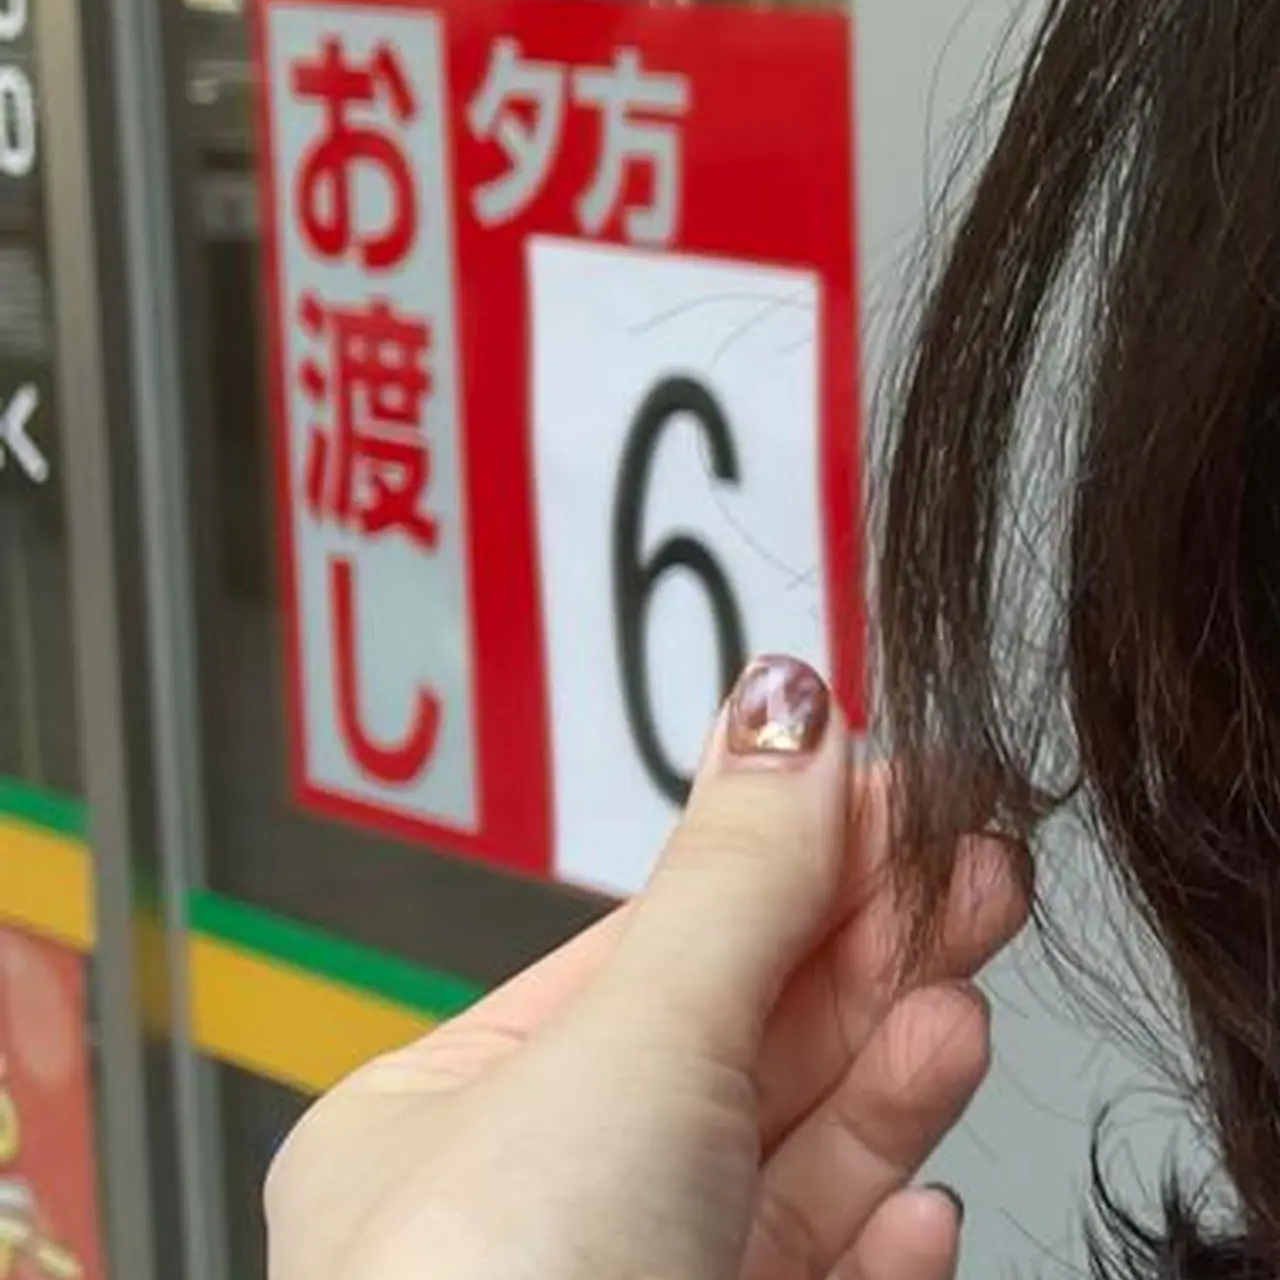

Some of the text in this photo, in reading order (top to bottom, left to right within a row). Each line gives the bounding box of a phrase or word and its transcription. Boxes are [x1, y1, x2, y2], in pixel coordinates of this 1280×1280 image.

[467, 38, 690, 246] 夕方
[289, 35, 443, 784] お渡し
[610, 369, 748, 810] 6
